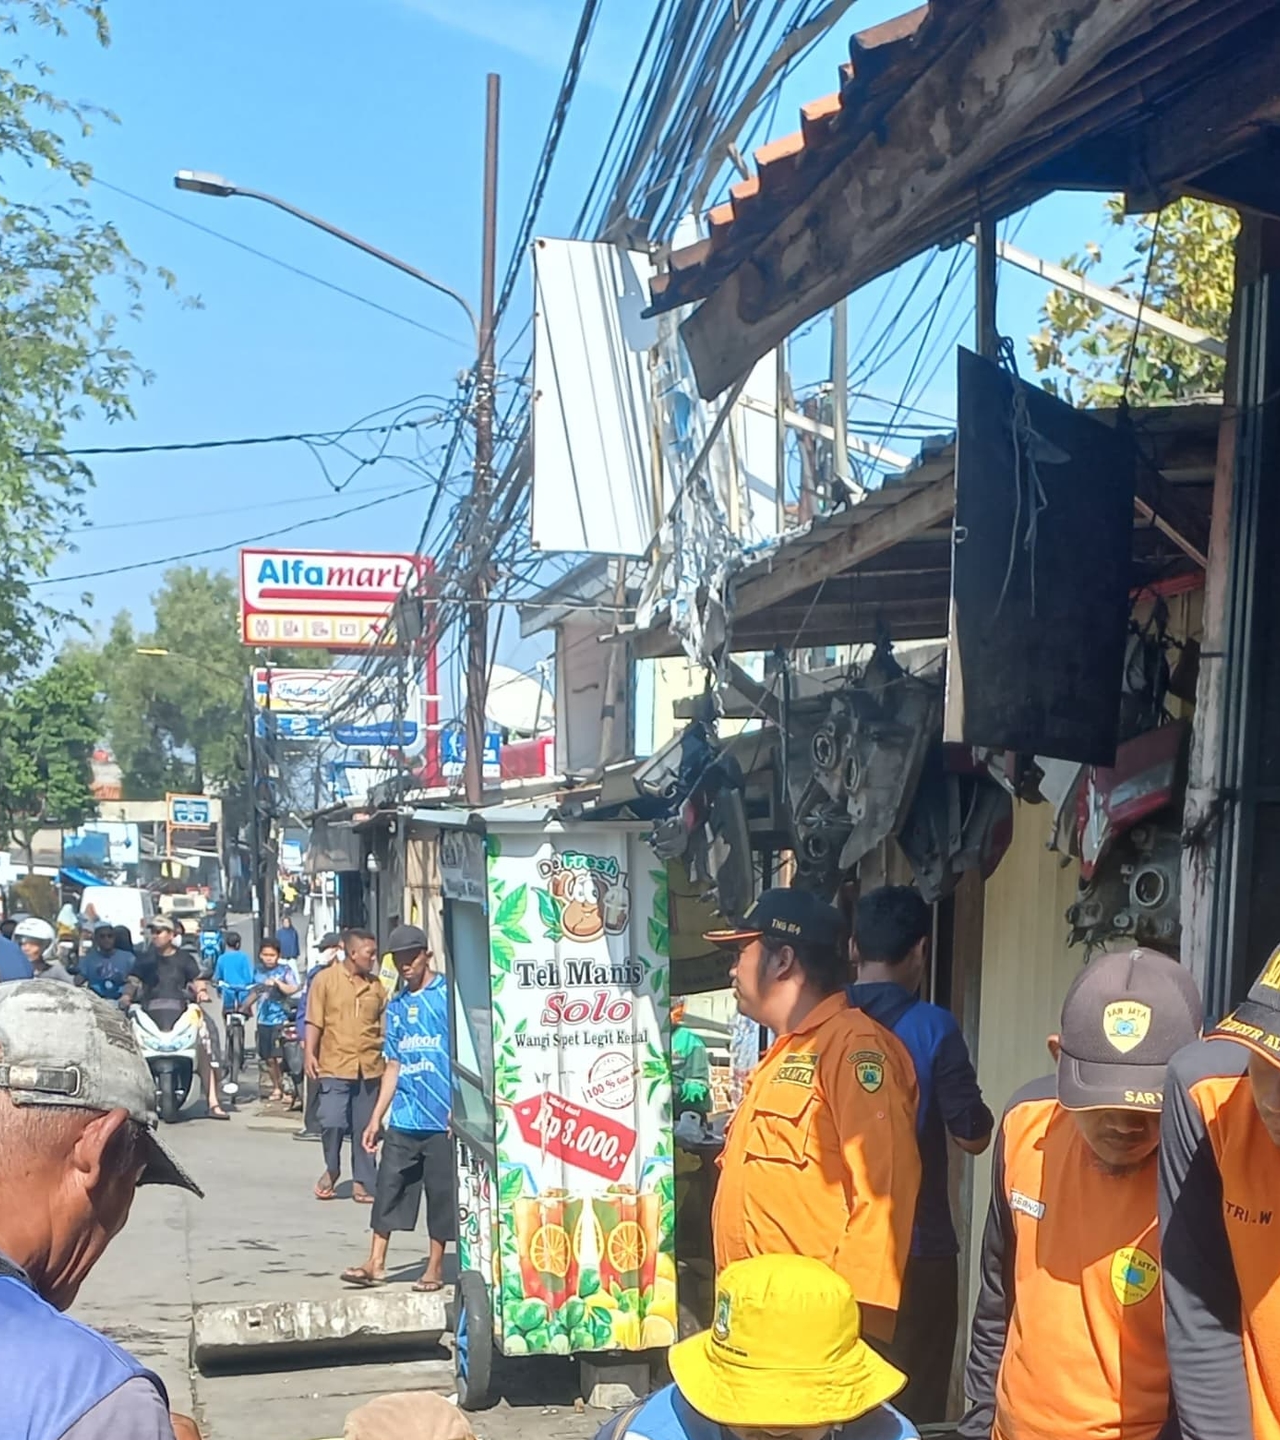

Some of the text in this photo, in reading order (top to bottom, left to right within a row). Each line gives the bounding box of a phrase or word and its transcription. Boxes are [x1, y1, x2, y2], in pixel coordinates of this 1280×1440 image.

[257, 558, 405, 588] Alfamart
[516, 959, 643, 987] Teh Manis
[541, 991, 633, 1026] Solo
[1128, 1006, 1147, 1020] MTA
[514, 1032, 551, 1049] Wangi
[583, 1031, 615, 1048] Legit
[586, 1082, 605, 1100] 100
[1124, 1090, 1157, 1105] SAR
